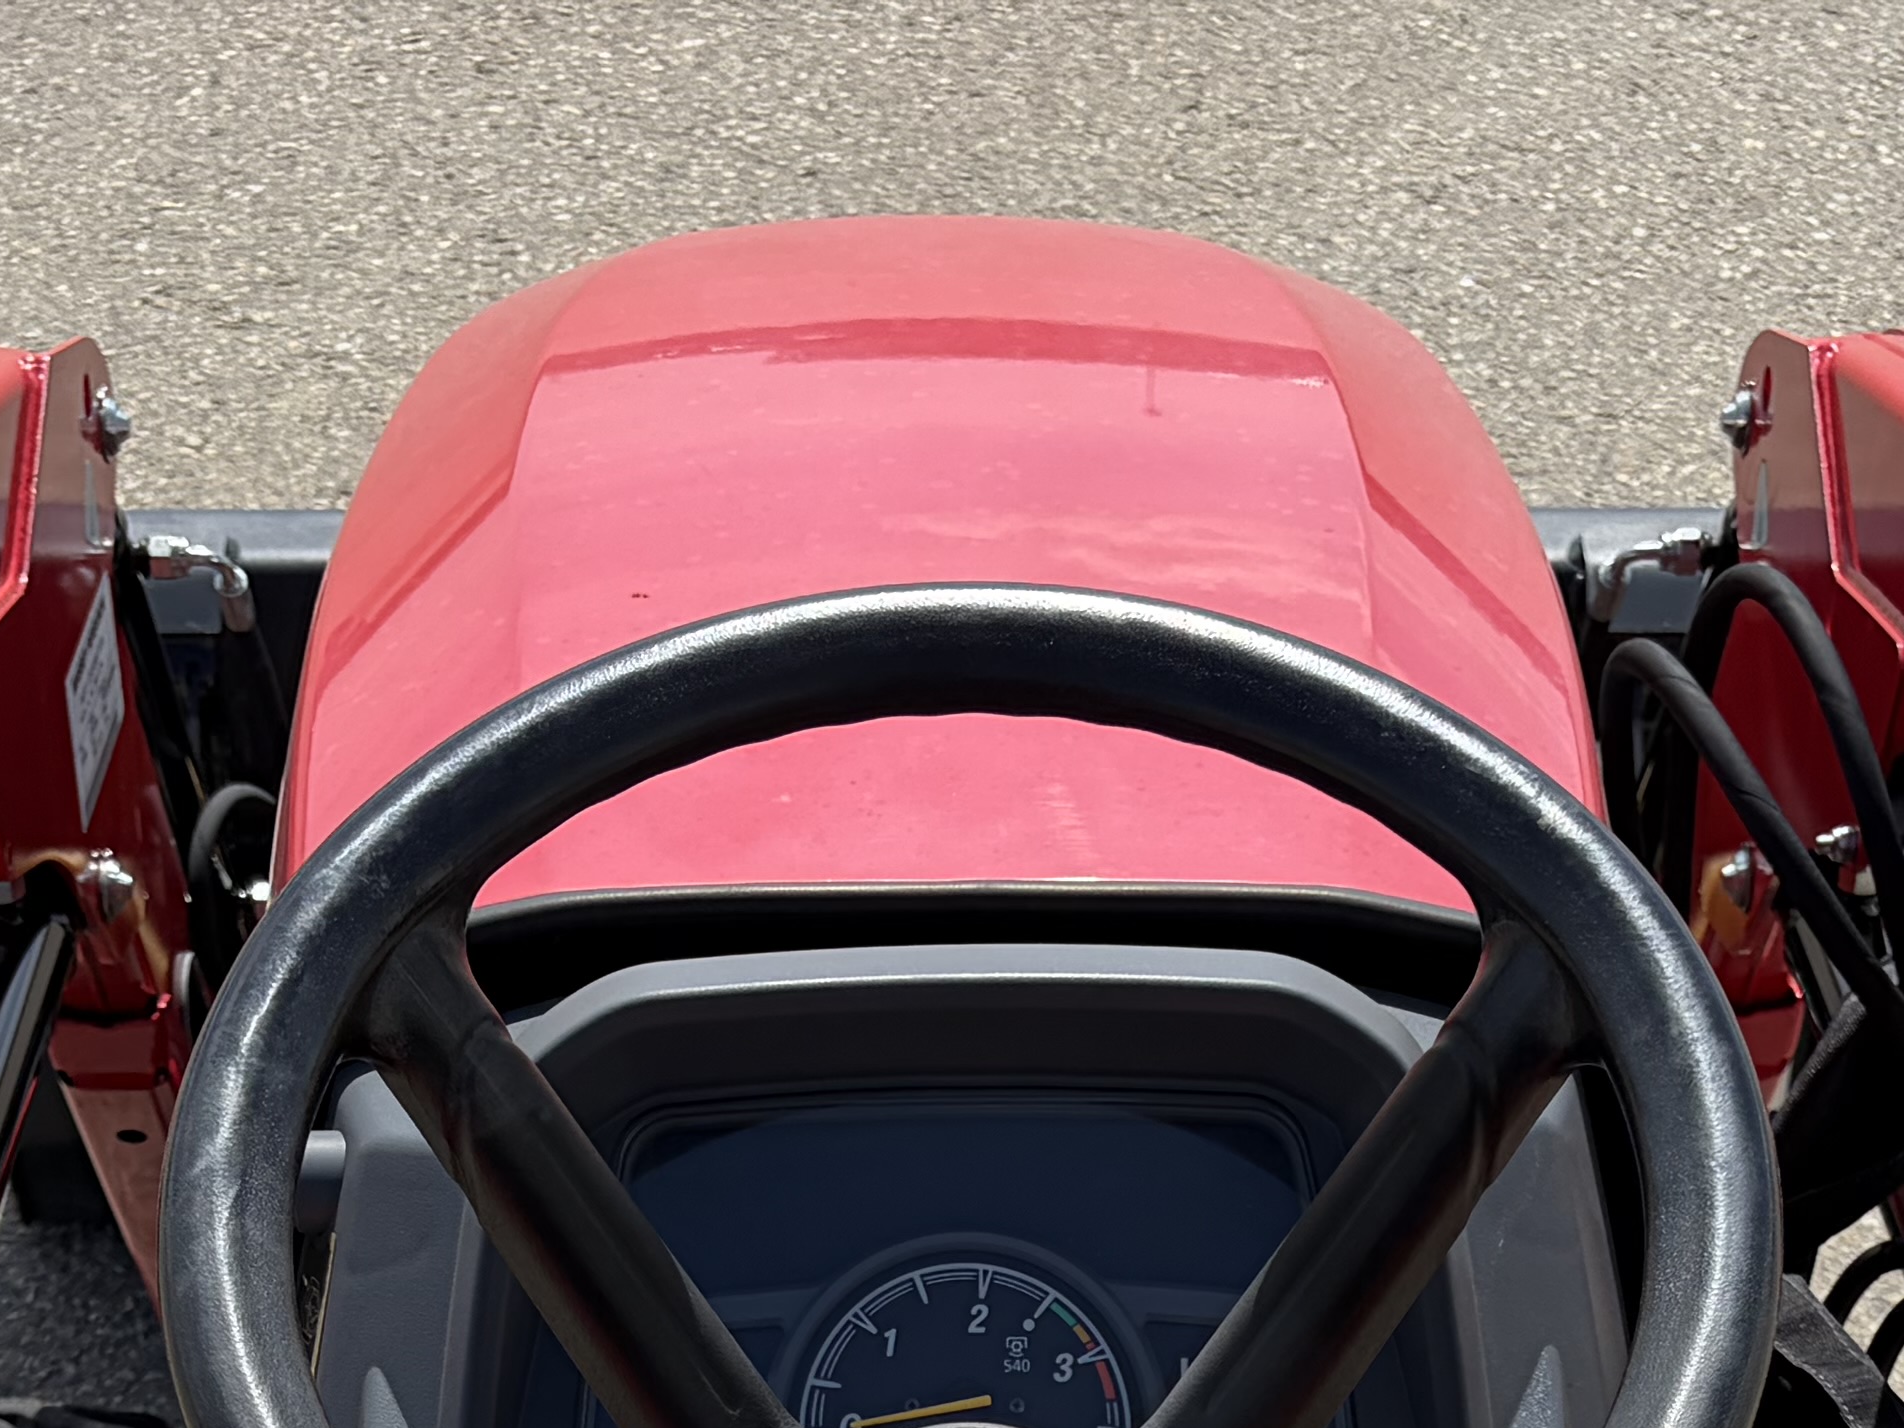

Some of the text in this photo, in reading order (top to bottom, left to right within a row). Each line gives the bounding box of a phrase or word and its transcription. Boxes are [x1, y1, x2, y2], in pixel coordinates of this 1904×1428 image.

[968, 1305, 990, 1333] 2
[882, 1328, 897, 1357] 1
[1003, 1358, 1032, 1374] 540
[1053, 1353, 1075, 1383] 3
